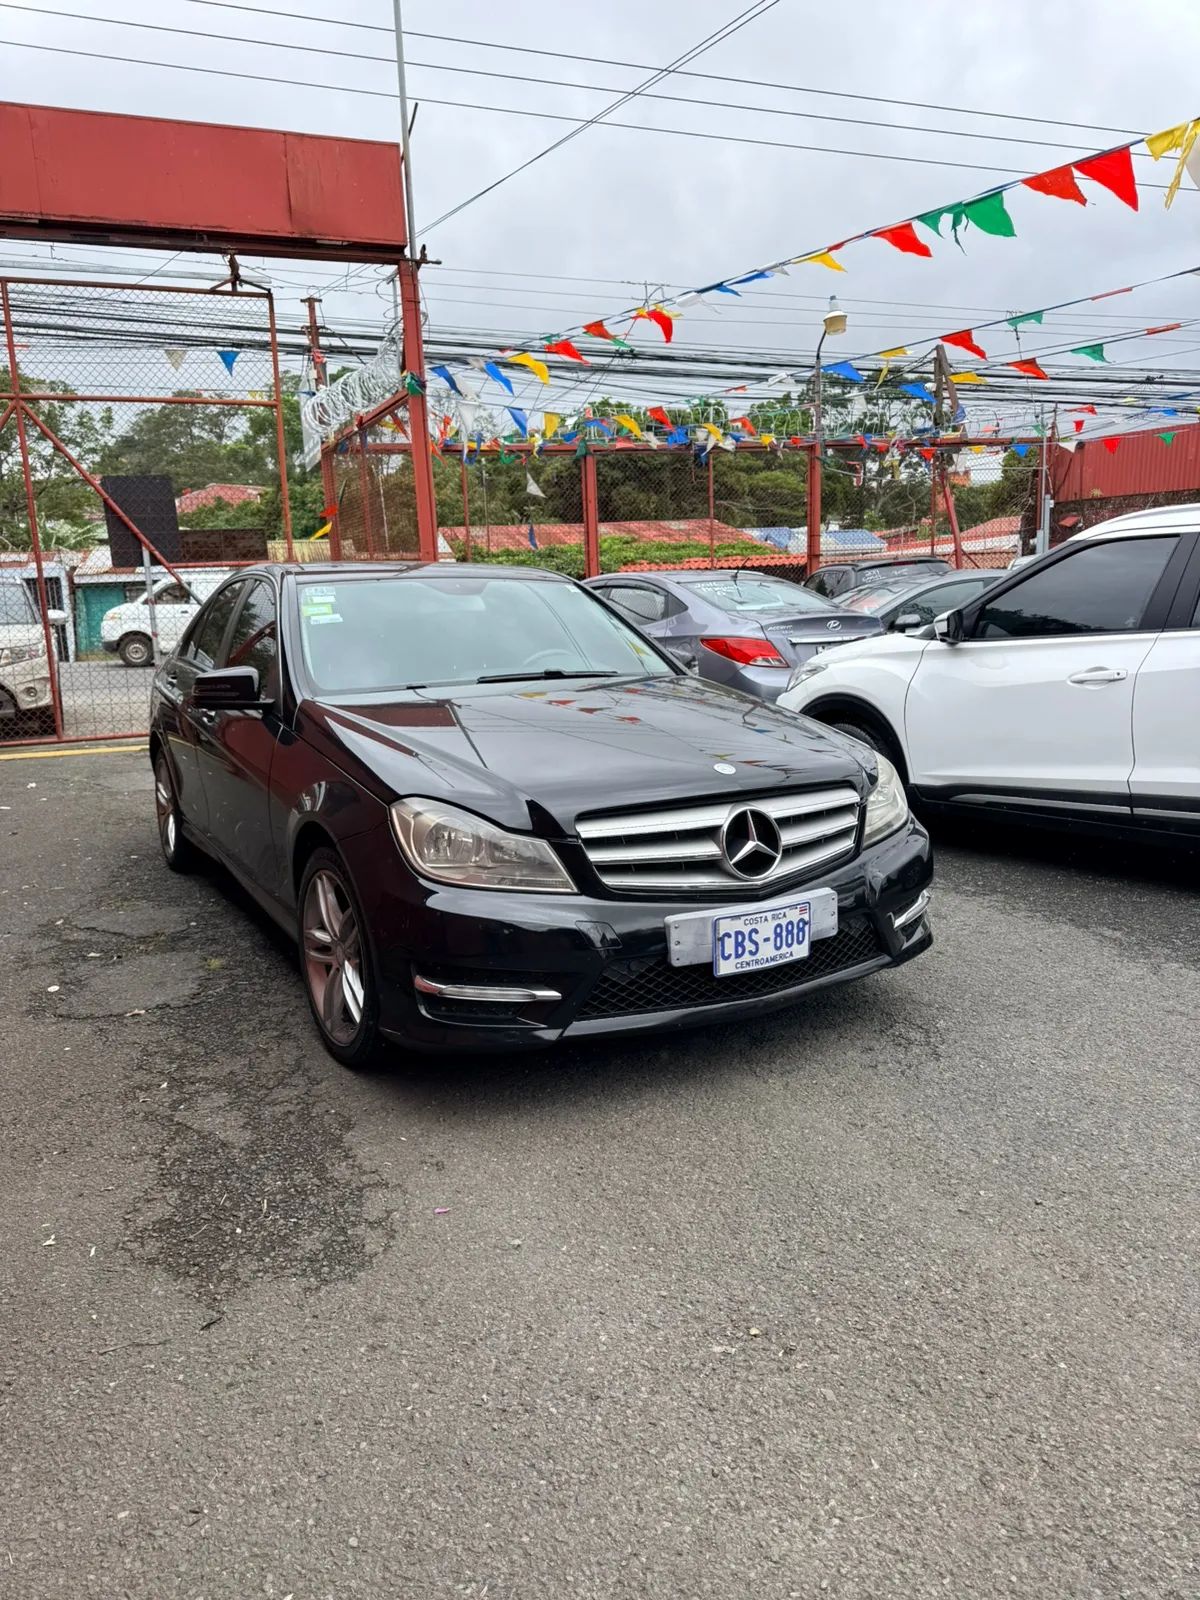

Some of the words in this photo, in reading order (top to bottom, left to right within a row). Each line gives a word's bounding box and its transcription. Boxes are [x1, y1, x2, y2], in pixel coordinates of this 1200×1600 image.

[744, 915, 769, 926] COSTA
[771, 911, 788, 922] RICA
[719, 918, 806, 961] CBS-888
[735, 950, 795, 970] CENTROAMERICA
